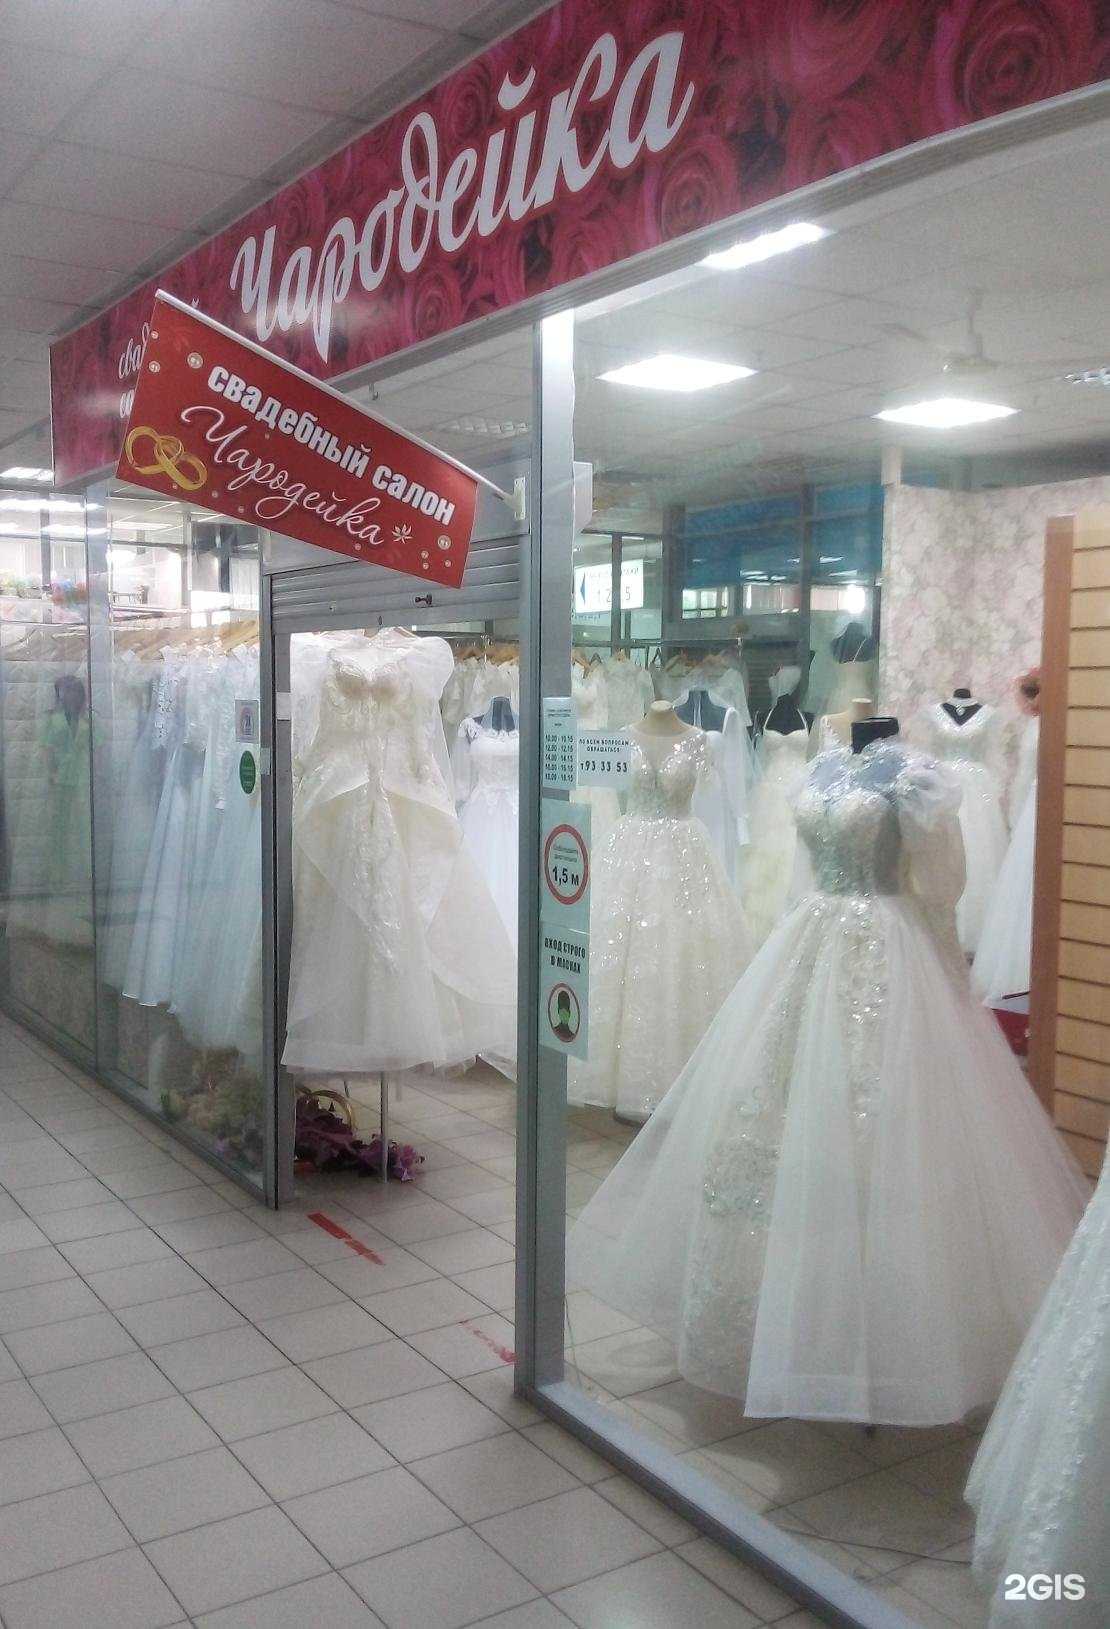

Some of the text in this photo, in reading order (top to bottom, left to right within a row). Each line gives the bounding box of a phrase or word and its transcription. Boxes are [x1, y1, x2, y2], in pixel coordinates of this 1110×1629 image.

[229, 31, 697, 363] Чародейка
[180, 405, 385, 546] Чародейка
[207, 364, 456, 527] свадебный салон
[600, 760, 611, 772] 33
[616, 762, 628, 773] 53
[552, 865, 569, 886] 1,5
[544, 937, 586, 960] ВХОД СТРОГО
